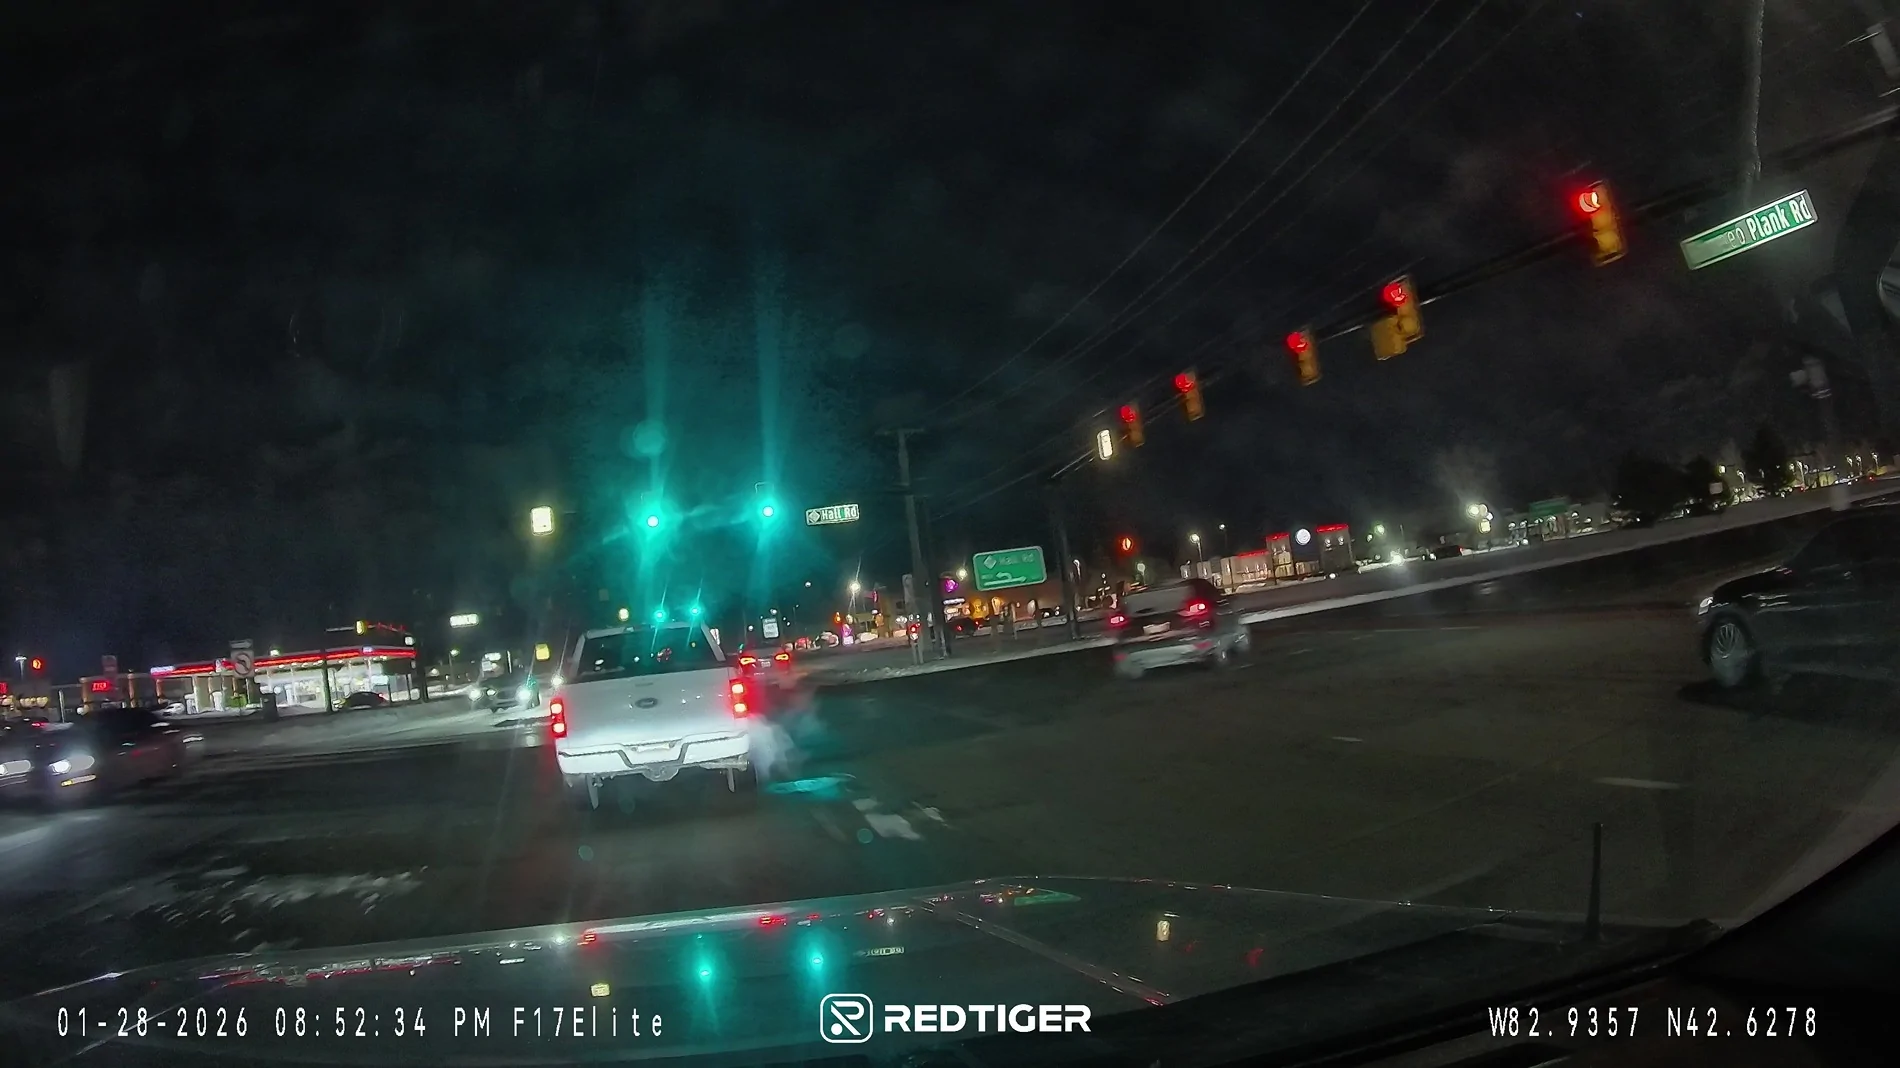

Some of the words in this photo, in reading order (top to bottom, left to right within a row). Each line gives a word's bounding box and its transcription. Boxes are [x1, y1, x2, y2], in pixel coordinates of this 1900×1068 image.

[1745, 206, 1790, 241] Plank
[1788, 195, 1812, 224] Rd
[821, 507, 842, 520] Hall
[844, 507, 857, 518] Rd
